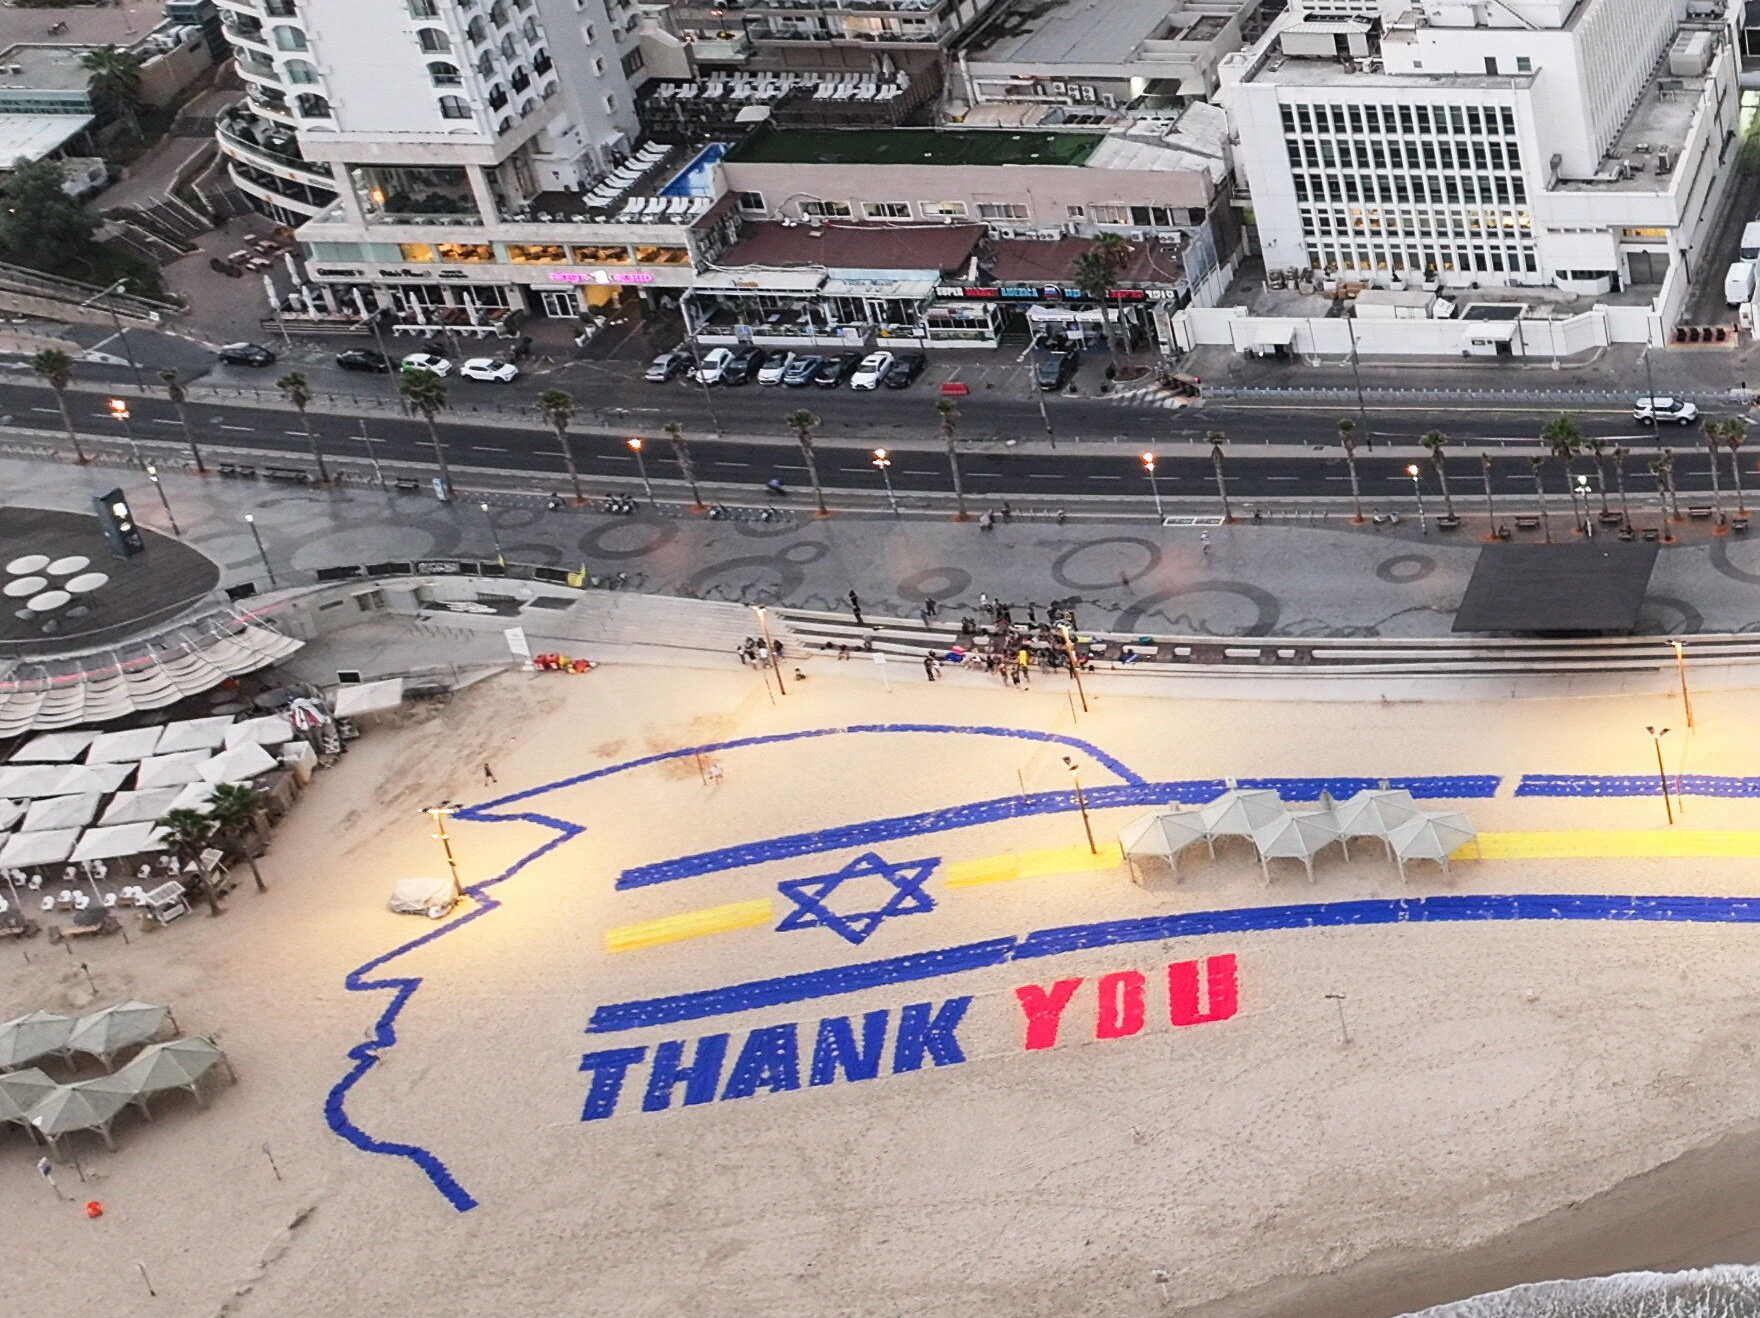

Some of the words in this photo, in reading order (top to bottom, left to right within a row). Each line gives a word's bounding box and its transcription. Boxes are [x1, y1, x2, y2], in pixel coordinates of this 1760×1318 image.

[936, 287, 964, 298] SUPER
[1001, 287, 1039, 299] AMERICA
[580, 996, 973, 1121] THANK
[1014, 953, 1240, 1051] YOU
